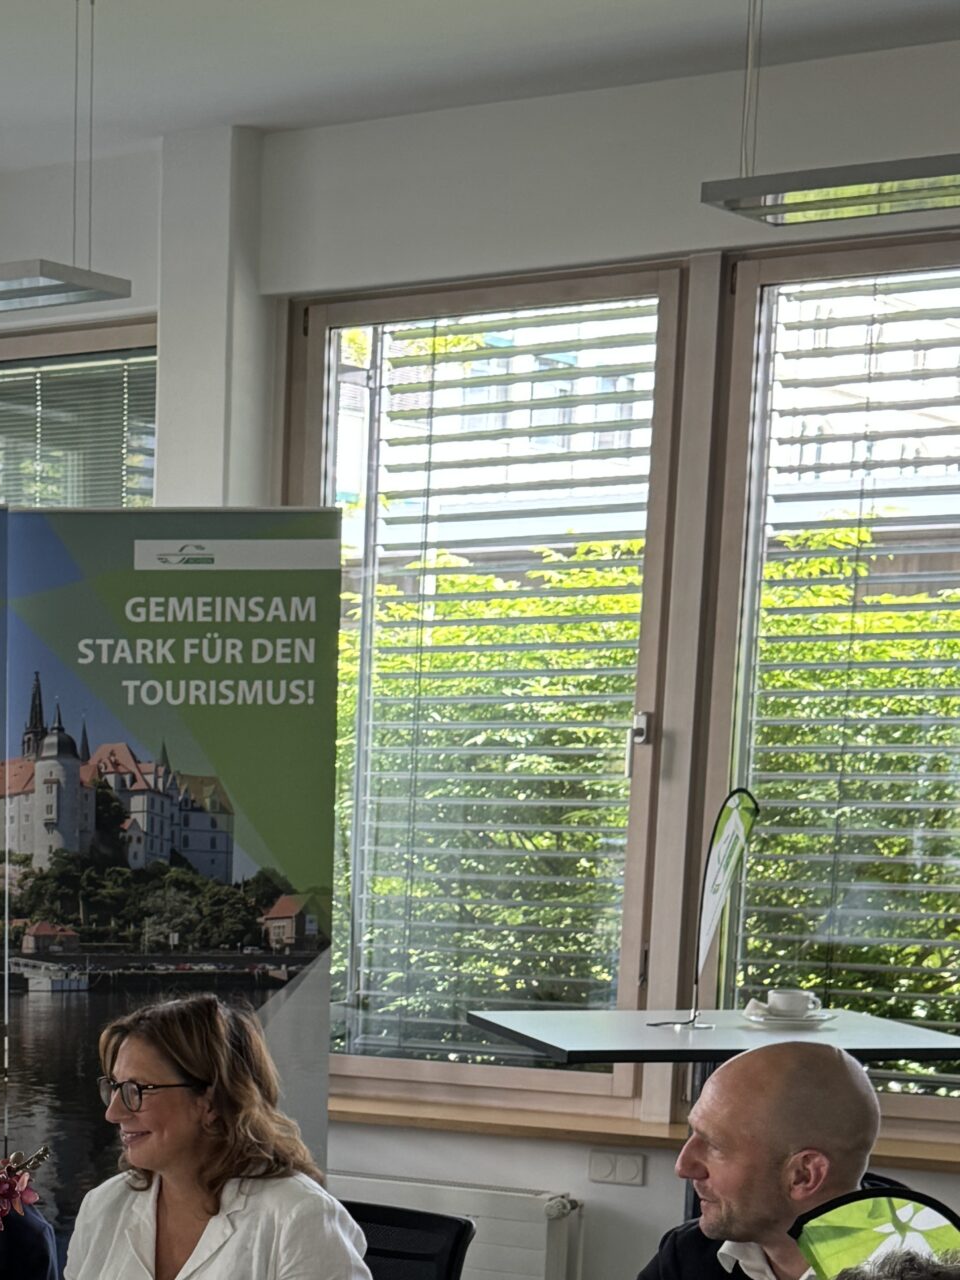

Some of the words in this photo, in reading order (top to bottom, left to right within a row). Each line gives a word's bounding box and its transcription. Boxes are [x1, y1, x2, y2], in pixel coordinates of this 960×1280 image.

[125, 596, 317, 622] GEMEINSAM
[77, 638, 176, 664] STARK
[184, 632, 243, 664] FÜR
[251, 638, 316, 663] DEN
[122, 679, 315, 706] TOURISMUS!
